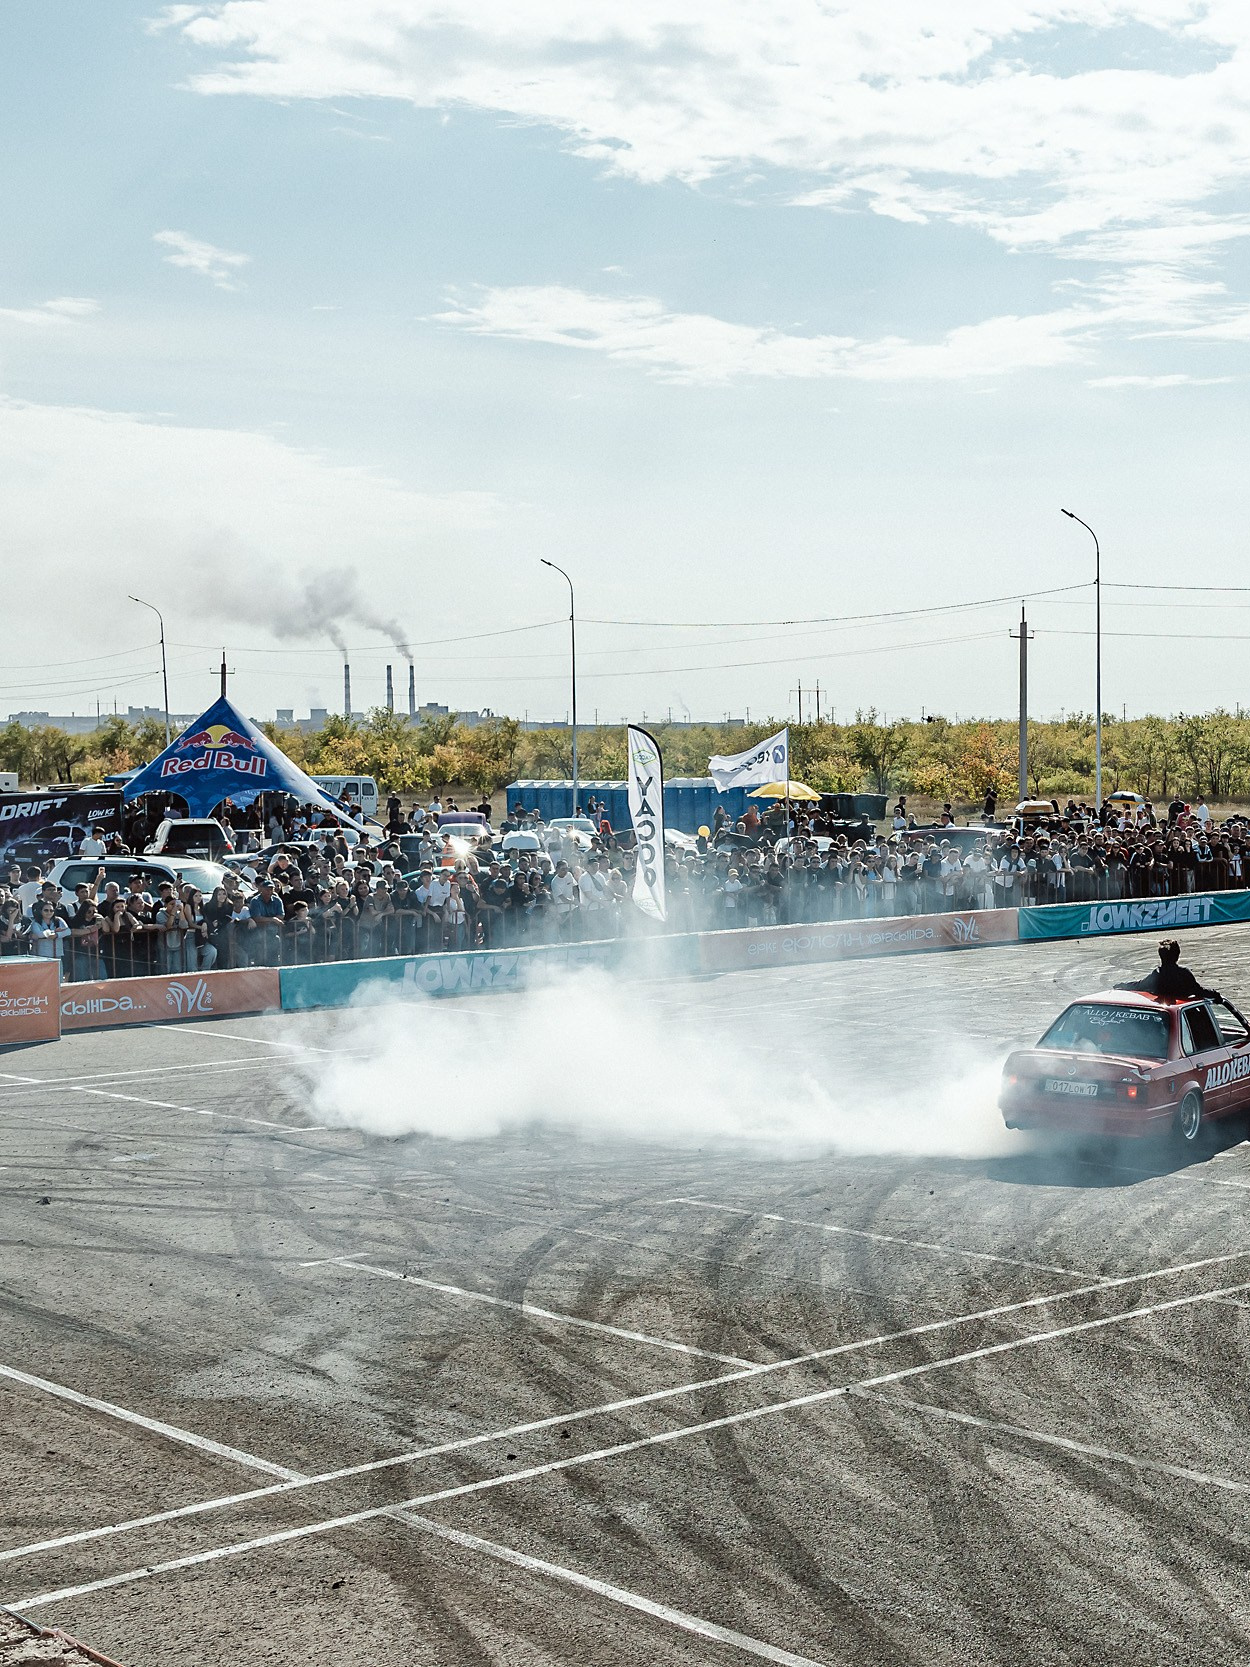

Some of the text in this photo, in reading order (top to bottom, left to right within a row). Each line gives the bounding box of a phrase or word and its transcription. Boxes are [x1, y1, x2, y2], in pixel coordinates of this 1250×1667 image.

[161, 750, 213, 778] Red
[213, 751, 267, 777] Bull
[0, 798, 67, 821] DRIFT
